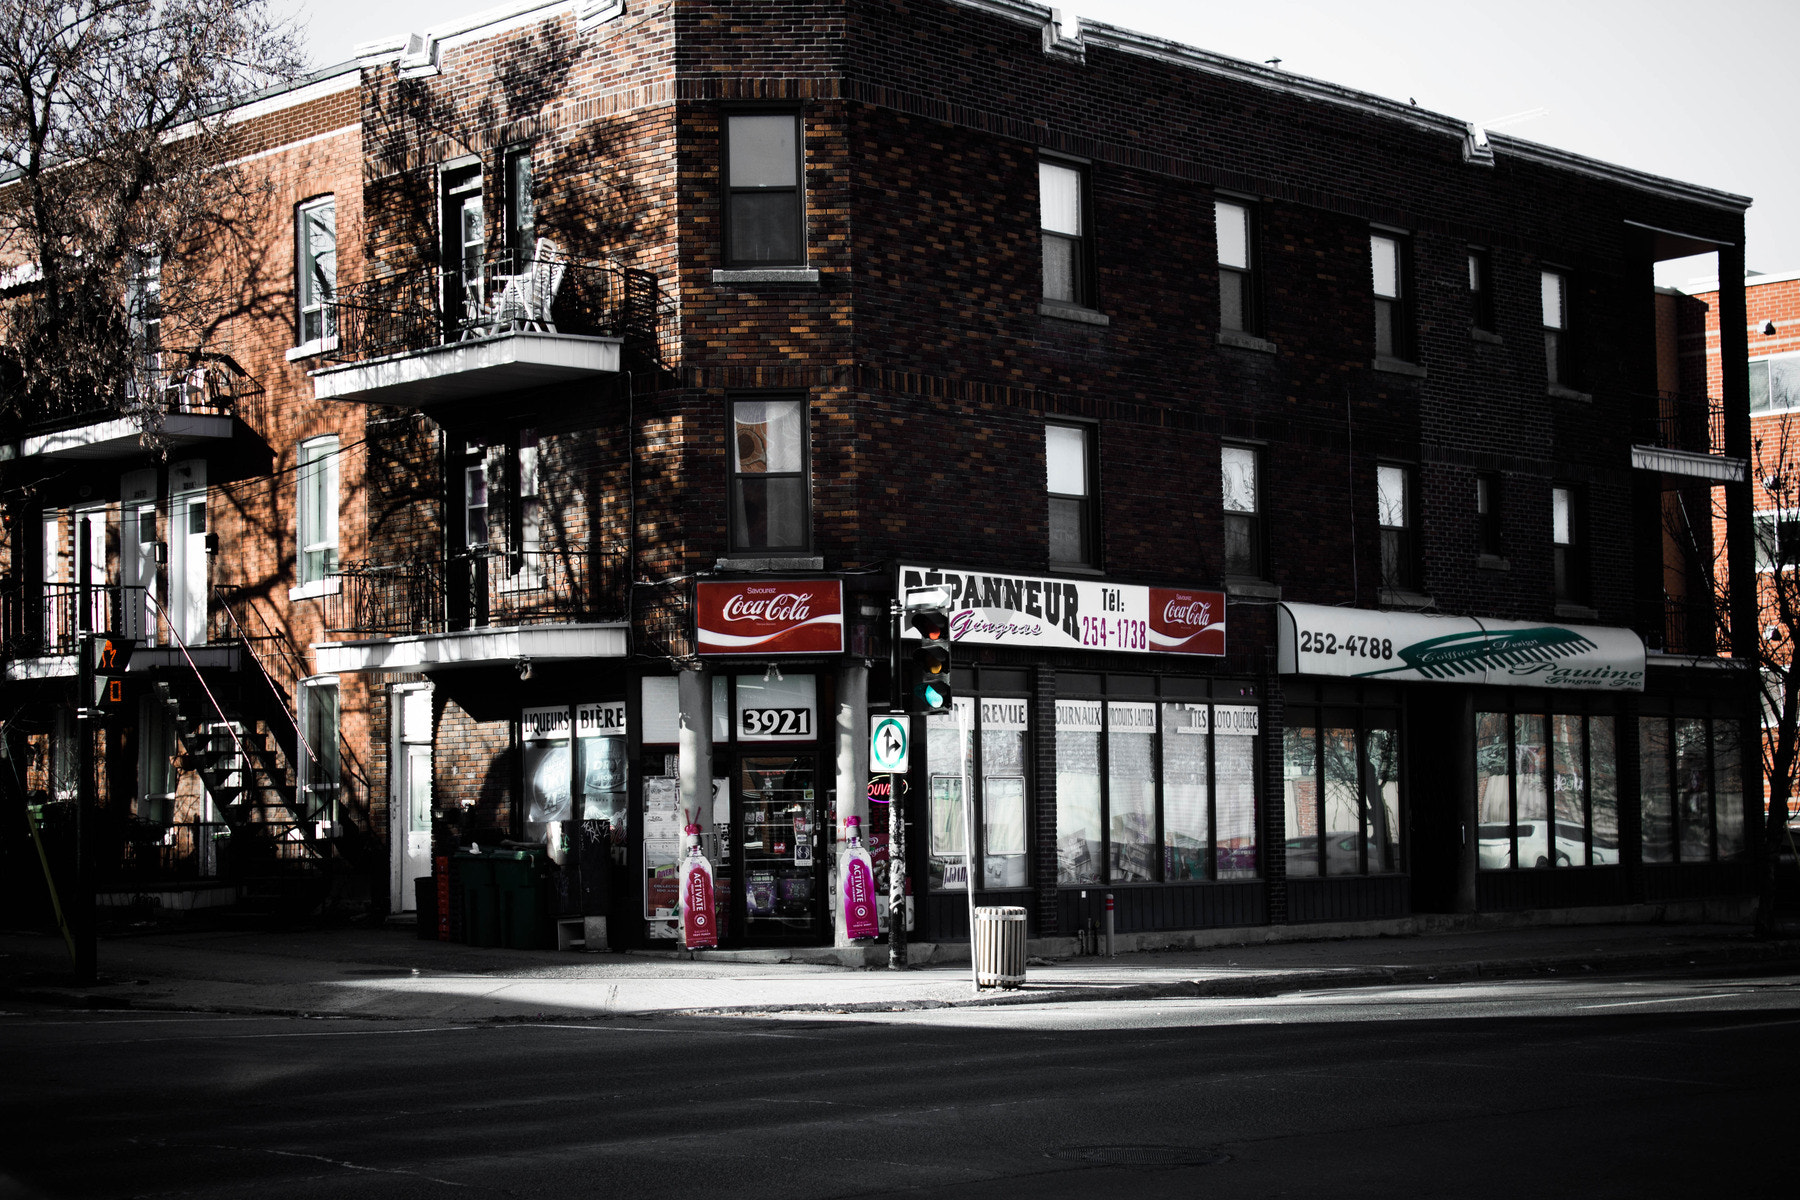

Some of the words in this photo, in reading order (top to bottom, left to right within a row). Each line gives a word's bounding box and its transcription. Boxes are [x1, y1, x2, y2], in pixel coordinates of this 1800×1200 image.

[722, 593, 814, 622] Coca-Cola
[1102, 588, 1125, 612] Tél:
[1163, 599, 1211, 626] Coca-Cola
[950, 610, 1042, 641] Gingras
[1082, 616, 1147, 650] 254-1738
[1300, 630, 1393, 660] 252-4788
[1492, 639, 1539, 651] Design
[1508, 661, 1643, 680] Pauline
[524, 710, 570, 736] LIQUEURS
[580, 704, 625, 730] BIÈRE
[744, 709, 808, 735] 3921
[982, 703, 1026, 724] REVUE
[1214, 710, 1232, 728] LOTO
[1233, 707, 1259, 732] QUÉBEC
[693, 872, 704, 912] ACTIVATE
[853, 864, 864, 903] ACTIVATE
